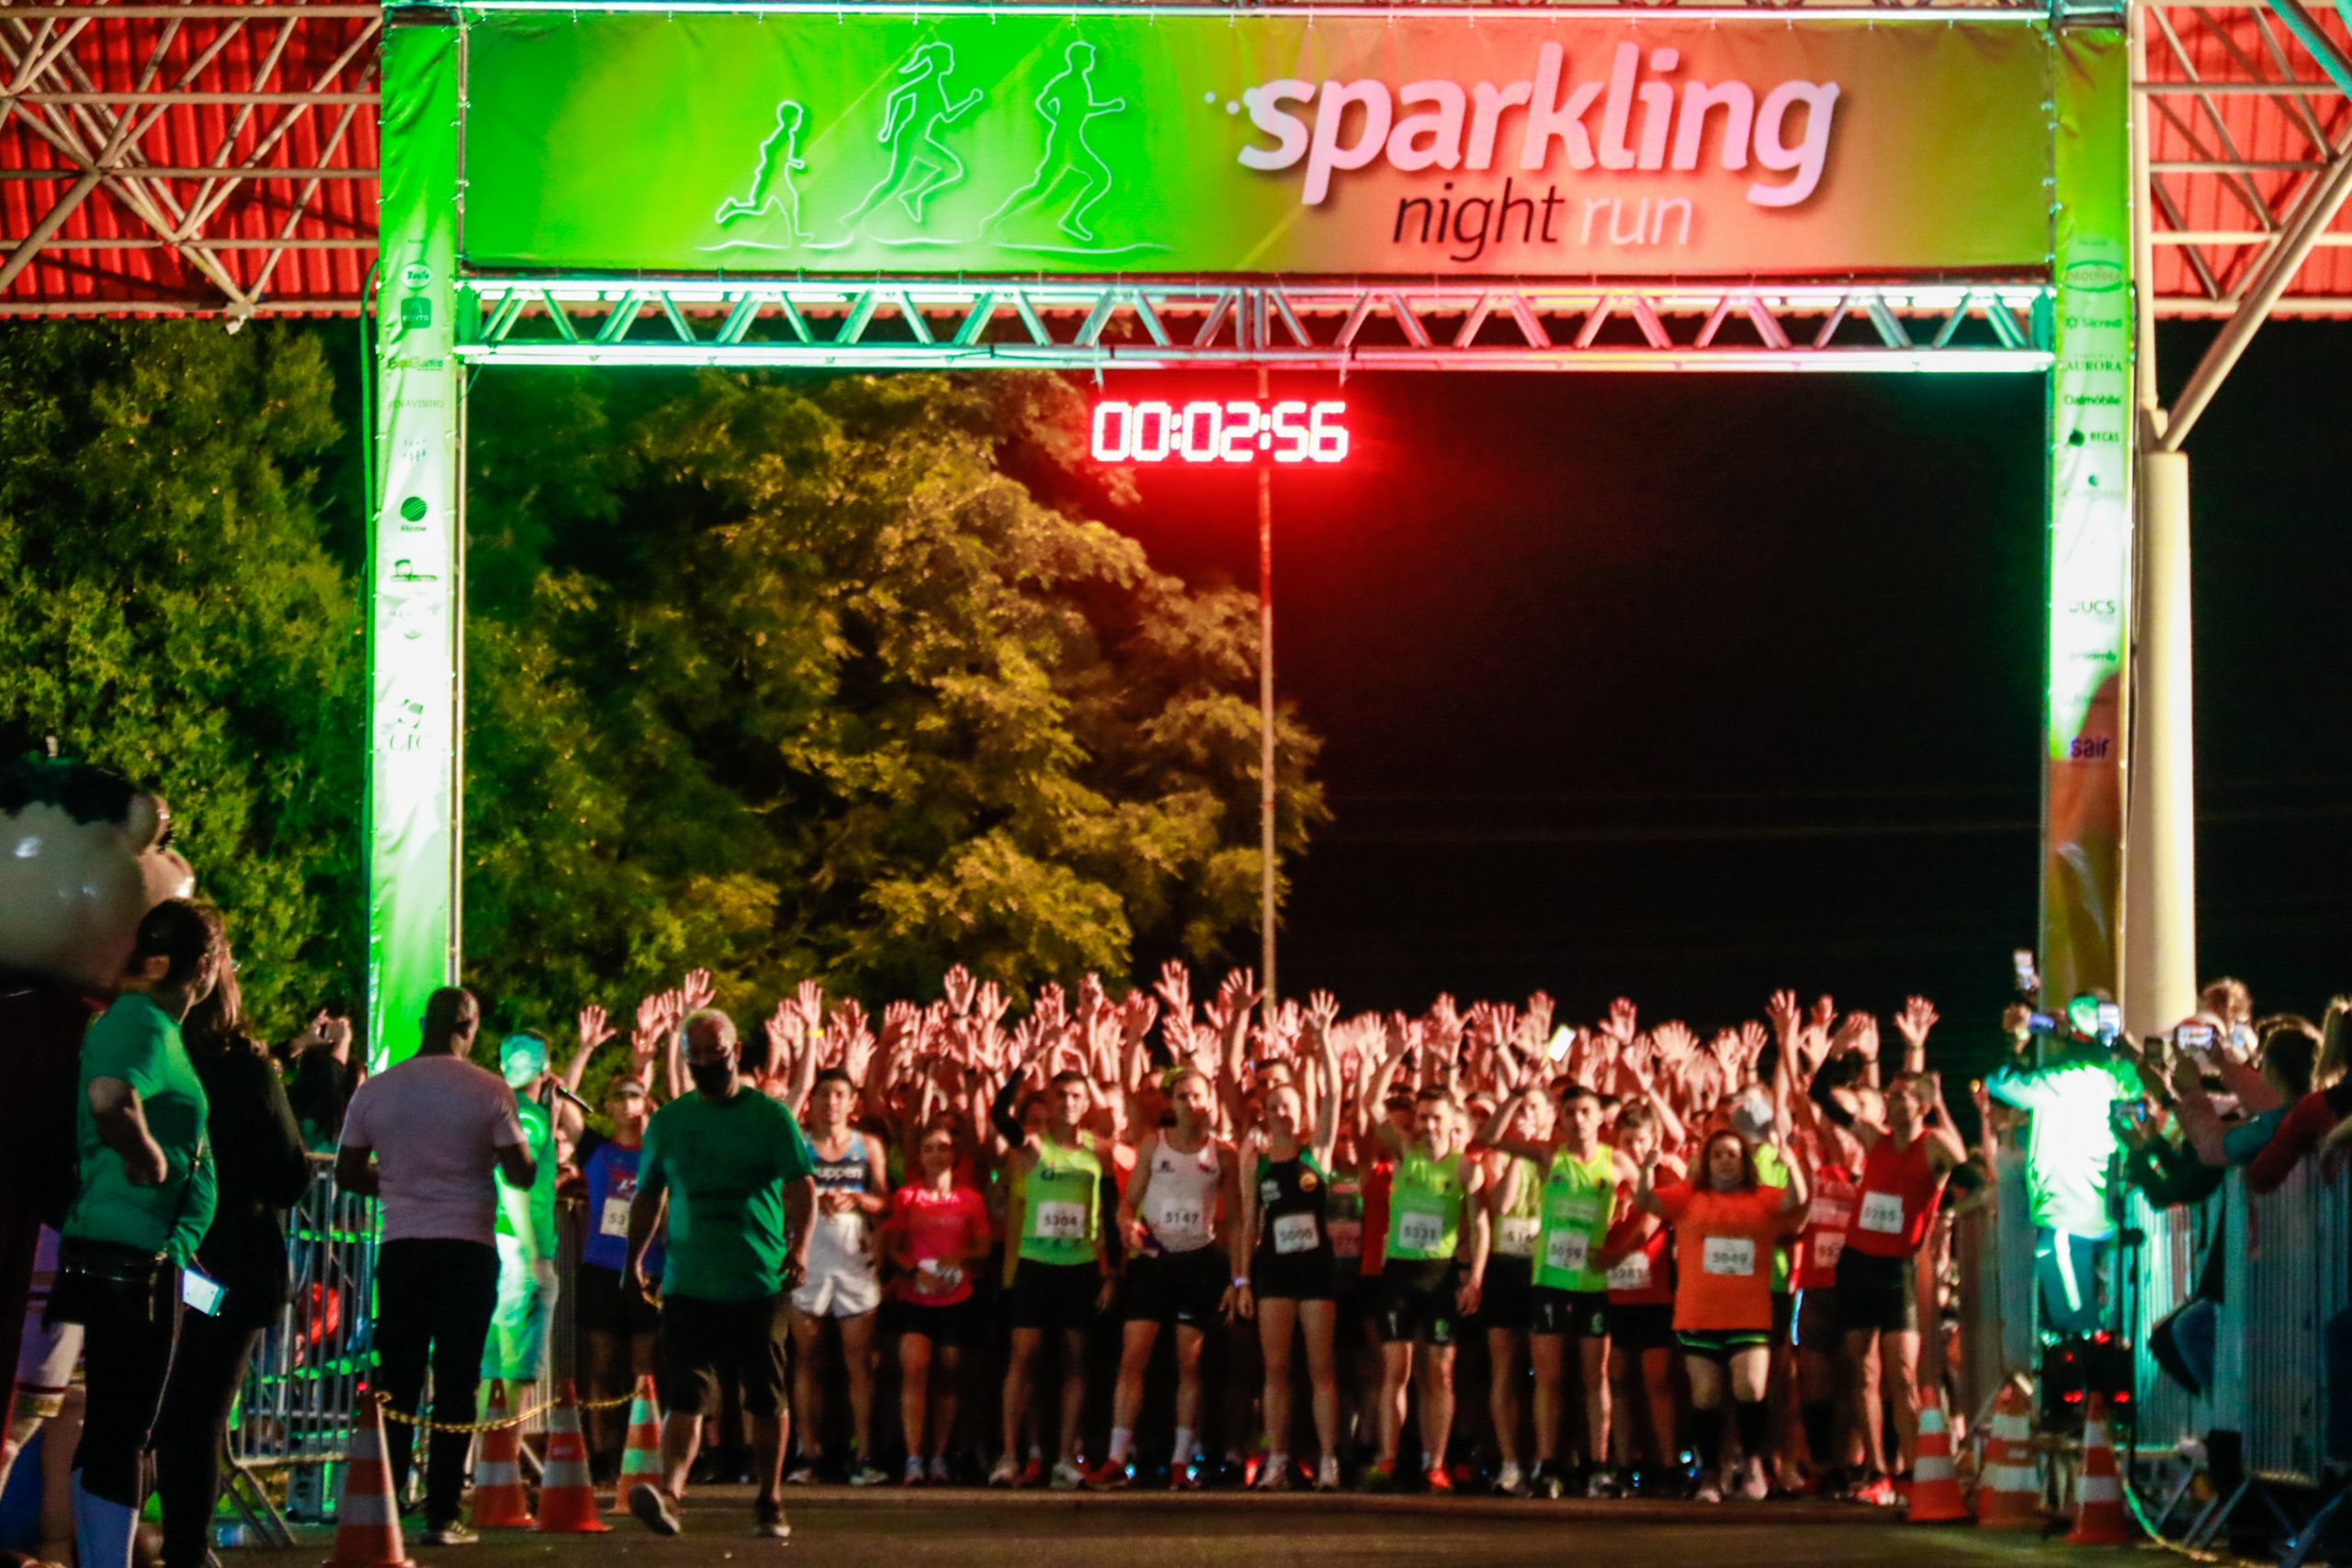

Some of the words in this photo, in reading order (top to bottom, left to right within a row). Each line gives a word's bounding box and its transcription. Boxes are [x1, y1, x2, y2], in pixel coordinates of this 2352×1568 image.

[1236, 41, 1840, 209] sparkling
[1393, 178, 1566, 262] night
[1579, 194, 1692, 245] run
[2066, 361, 2122, 371] AURORA
[1091, 400, 1350, 462] 00:02:56
[2081, 600, 2116, 614] UCS
[815, 1166, 863, 1181] uppen
